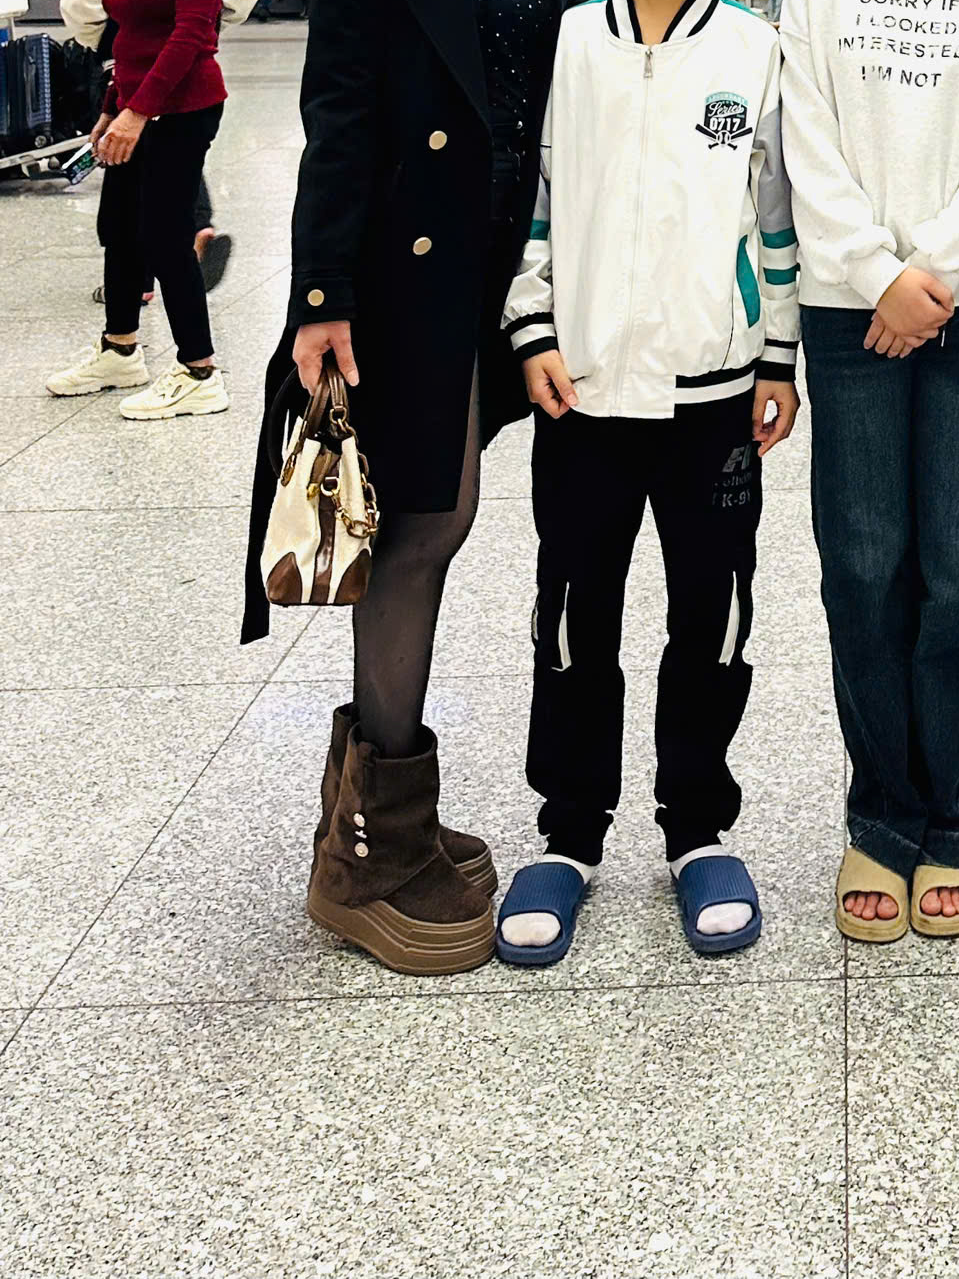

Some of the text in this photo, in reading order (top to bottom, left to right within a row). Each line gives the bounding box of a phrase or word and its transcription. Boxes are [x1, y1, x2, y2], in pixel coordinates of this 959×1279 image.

[870, 15, 957, 35] LOOKED
[900, 70, 942, 88] NOT
[707, 102, 745, 118] Series
[709, 118, 741, 132] 0717
